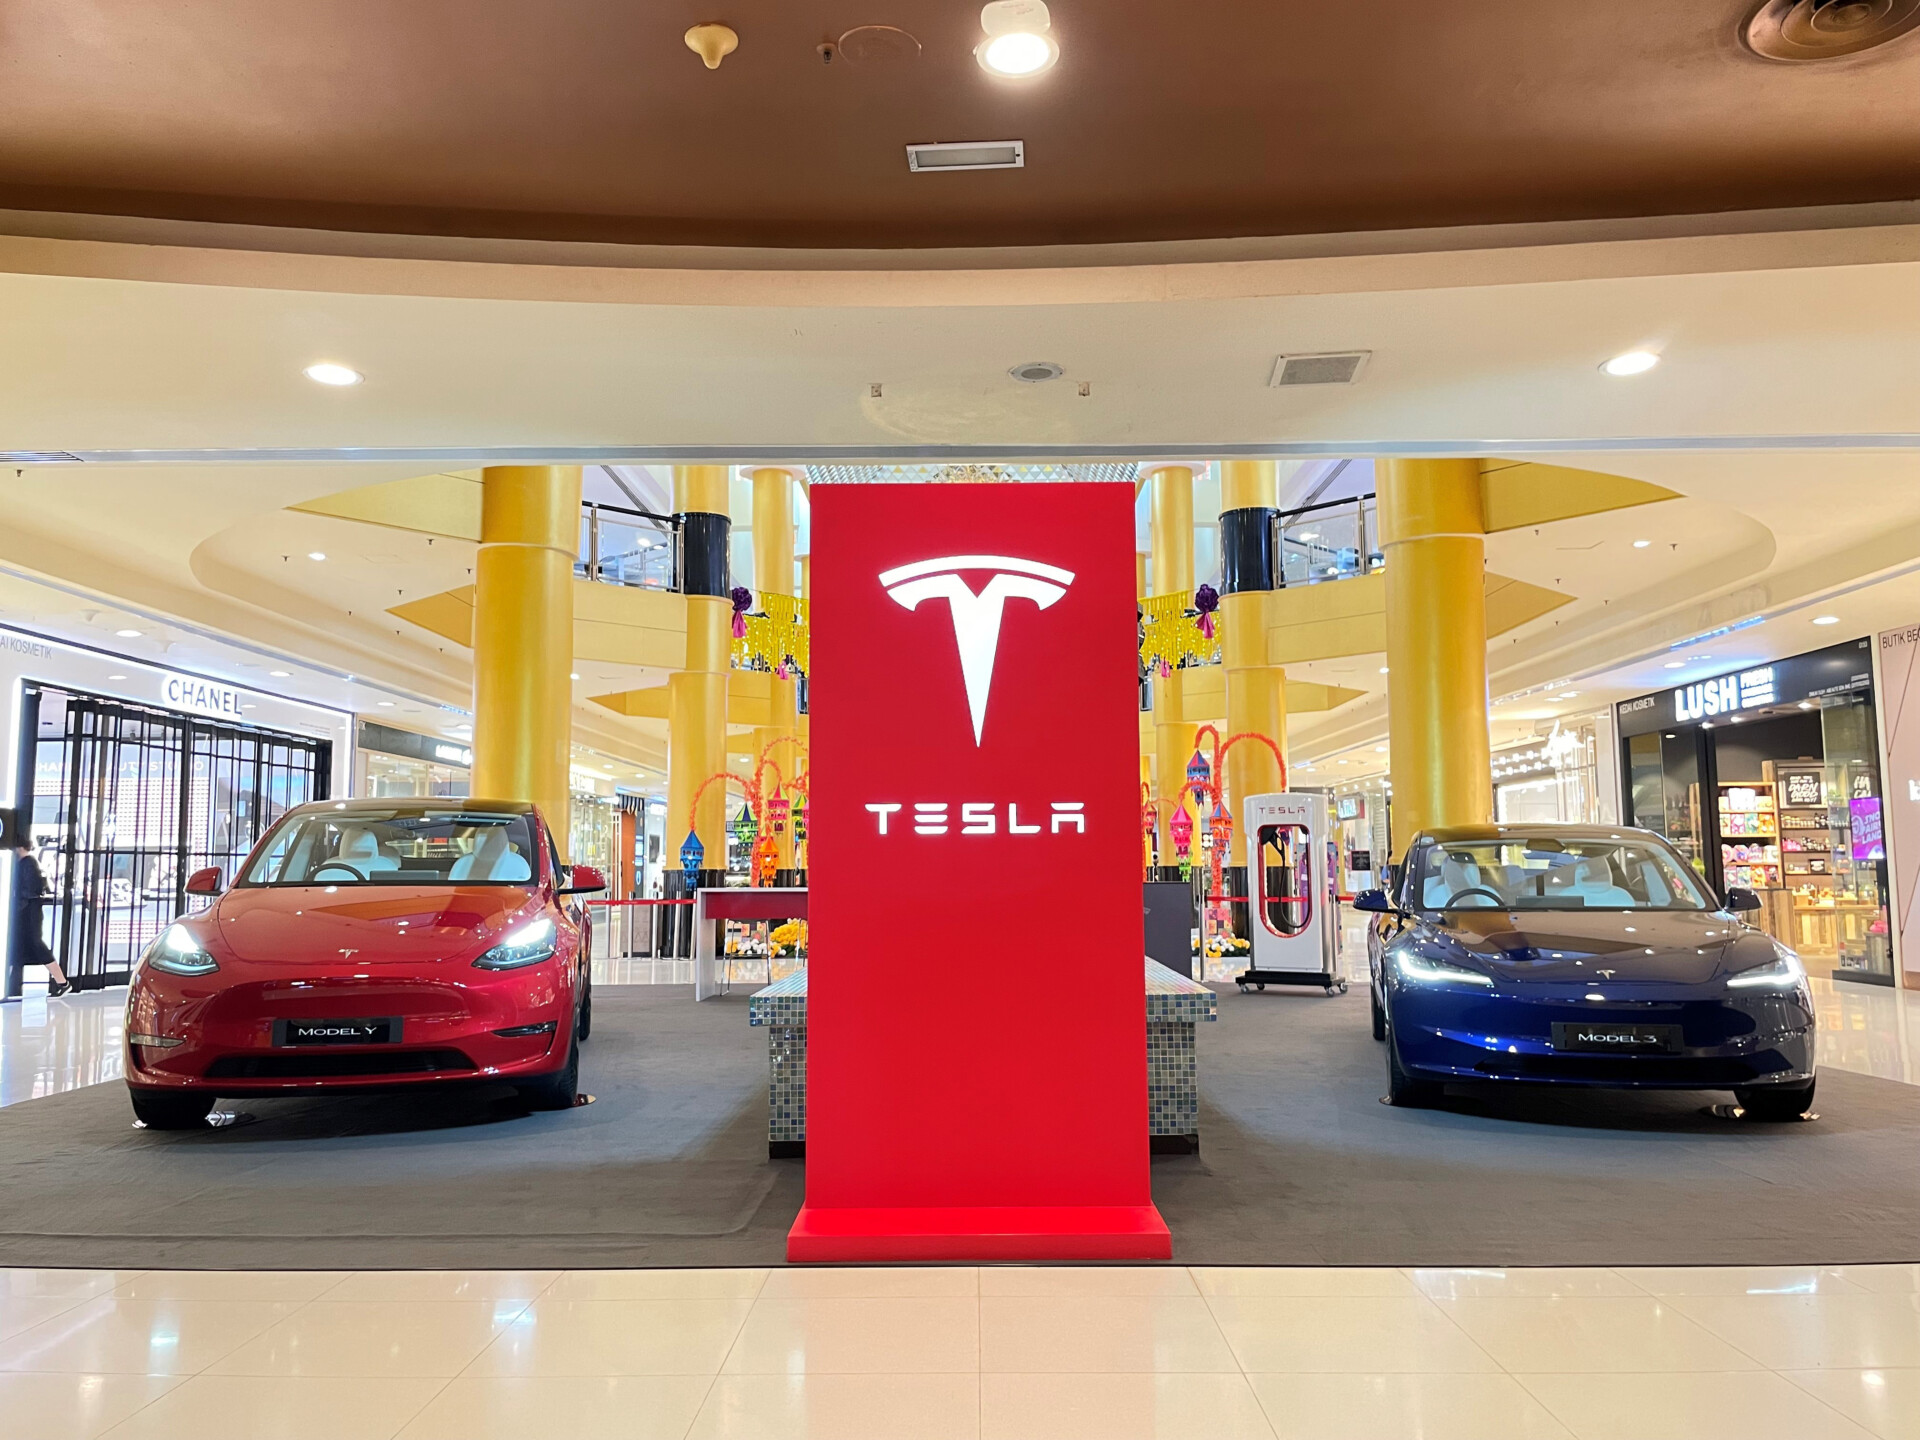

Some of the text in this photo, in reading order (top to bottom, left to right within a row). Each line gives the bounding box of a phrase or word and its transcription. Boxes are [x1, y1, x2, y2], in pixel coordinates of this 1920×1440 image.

[10, 638, 52, 660] KOSMETIK
[1882, 632, 1905, 648] BUTIK
[168, 679, 243, 716] CHANEL
[1674, 675, 1738, 722] LUSH
[865, 802, 1085, 834] TESLA
[1259, 806, 1306, 814] TESLA
[298, 1026, 377, 1036] MODEL Y
[1578, 1033, 1657, 1043] MODEL 3
